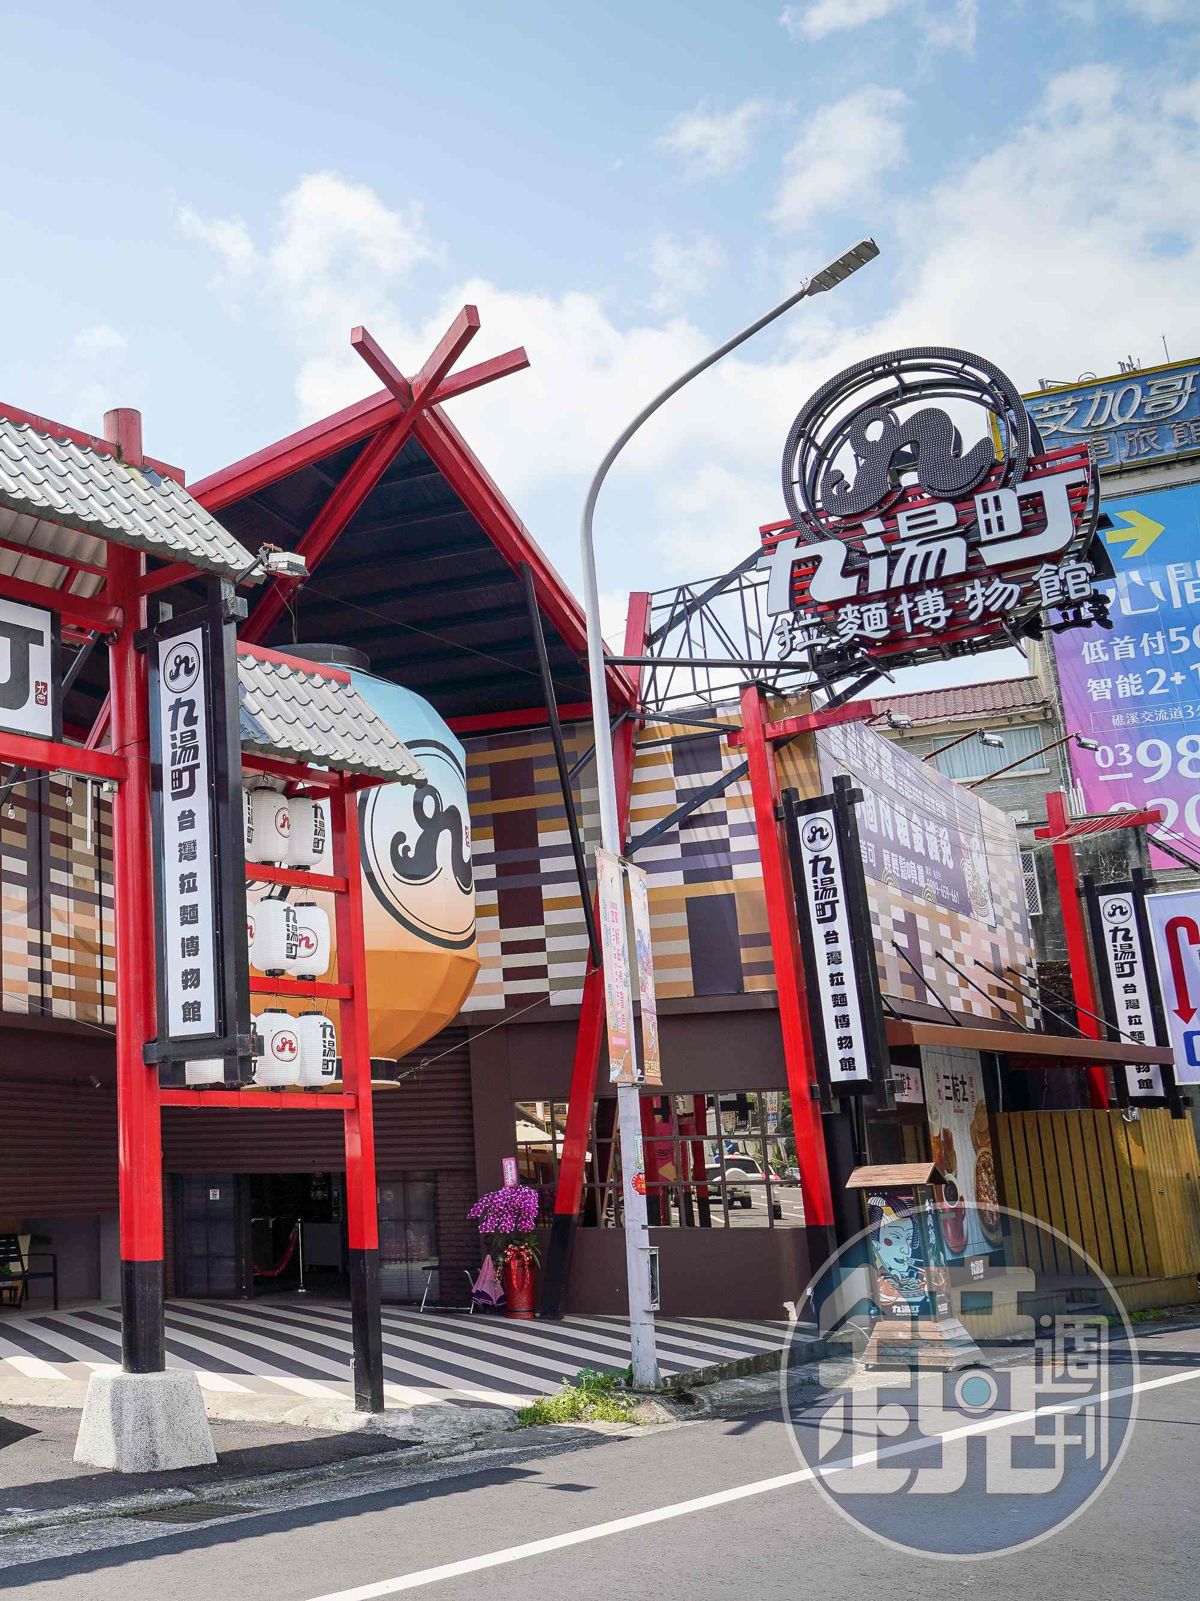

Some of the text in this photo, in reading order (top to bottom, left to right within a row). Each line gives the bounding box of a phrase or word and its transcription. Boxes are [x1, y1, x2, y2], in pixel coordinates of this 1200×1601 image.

[756, 472, 1086, 617] 九湯町
[775, 560, 1095, 659] 拉麵博物館
[167, 697, 202, 1023] 九湯町 台灣拉麵博物館
[809, 855, 857, 1073] 九湯町 台灣拉麵博物館
[1108, 926, 1153, 1090] 九湯町 台灣拉麵物館
[320, 1022, 336, 1076] 九湯町
